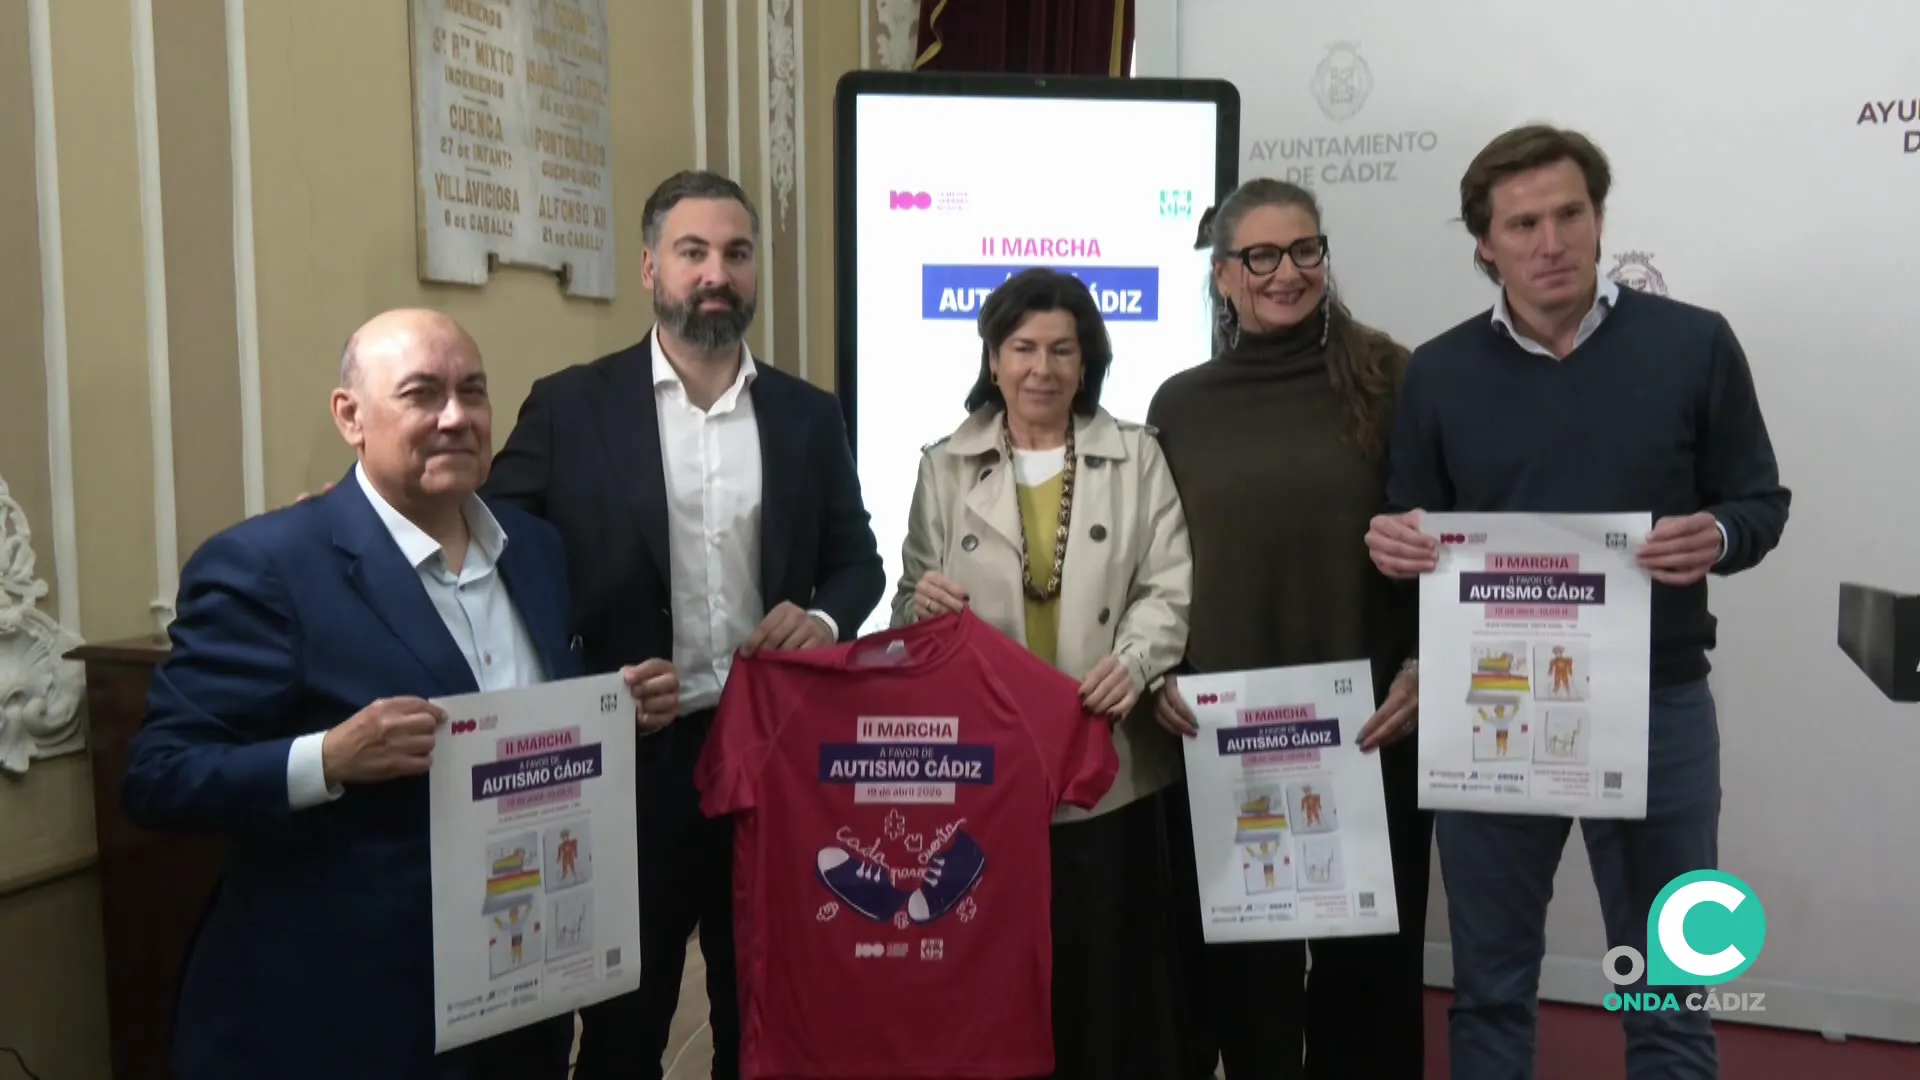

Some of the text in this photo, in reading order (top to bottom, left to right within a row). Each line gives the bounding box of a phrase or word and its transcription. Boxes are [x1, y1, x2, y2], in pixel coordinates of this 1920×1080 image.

[475, 40, 514, 76] MIXTO
[444, 64, 504, 99] INGENIEROS
[449, 104, 504, 143] CUENCA
[1856, 98, 1920, 125] AYU
[440, 136, 453, 154] 27
[1248, 130, 1439, 162] AYUNTAMIENTO
[1286, 158, 1398, 186] DE CÁDIZ
[434, 172, 520, 213] VILLAVICIOSA
[538, 195, 589, 225] ALFONSO
[981, 237, 1102, 257] II MARCHA
[938, 287, 996, 313] AUT
[1494, 557, 1569, 569] II MARCHA
[1469, 582, 1596, 601] AUTISMO CÁDIZ
[1255, 707, 1309, 723] MARCHA
[506, 730, 573, 755] II MARCHA
[862, 723, 953, 738] II MARCHA
[1227, 729, 1333, 753] AUTISMO CÁDIZ
[880, 748, 934, 759] A FAVOR DE
[482, 758, 595, 795] AUTISMO CÁDIZ
[829, 755, 983, 779] AUTISMO CÁDIZ
[879, 787, 891, 797] de
[893, 786, 914, 797] abril
[916, 787, 943, 797] 2026
